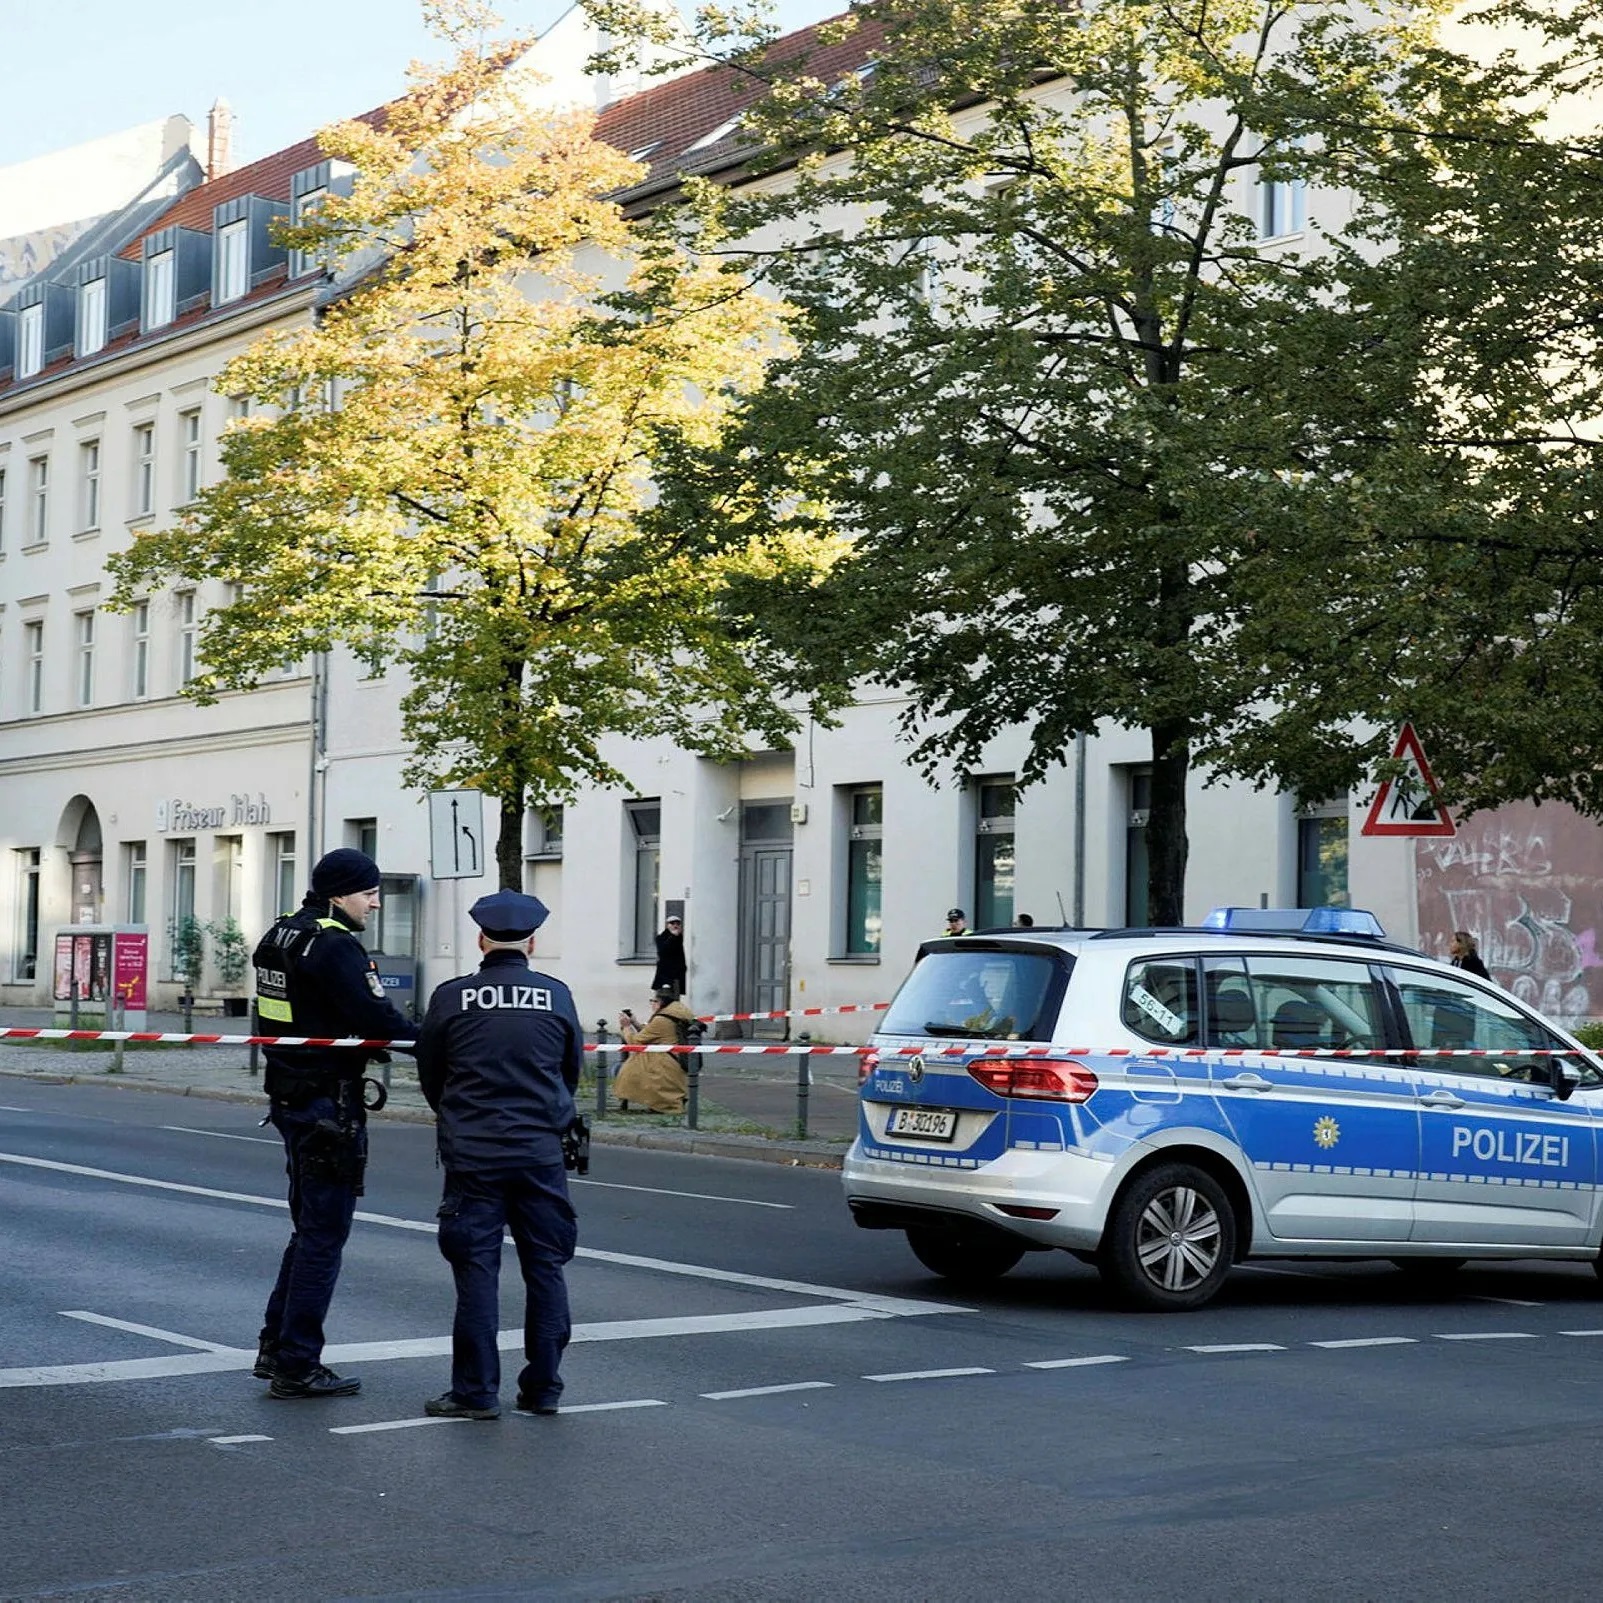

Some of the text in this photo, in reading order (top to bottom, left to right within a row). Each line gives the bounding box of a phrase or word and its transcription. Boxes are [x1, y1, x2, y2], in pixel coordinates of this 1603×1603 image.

[172, 799, 226, 831] Friseur
[461, 985, 553, 1011] POLIZEI
[875, 1080, 904, 1094] POLIZEI
[1452, 1126, 1569, 1168] POLIZEI
